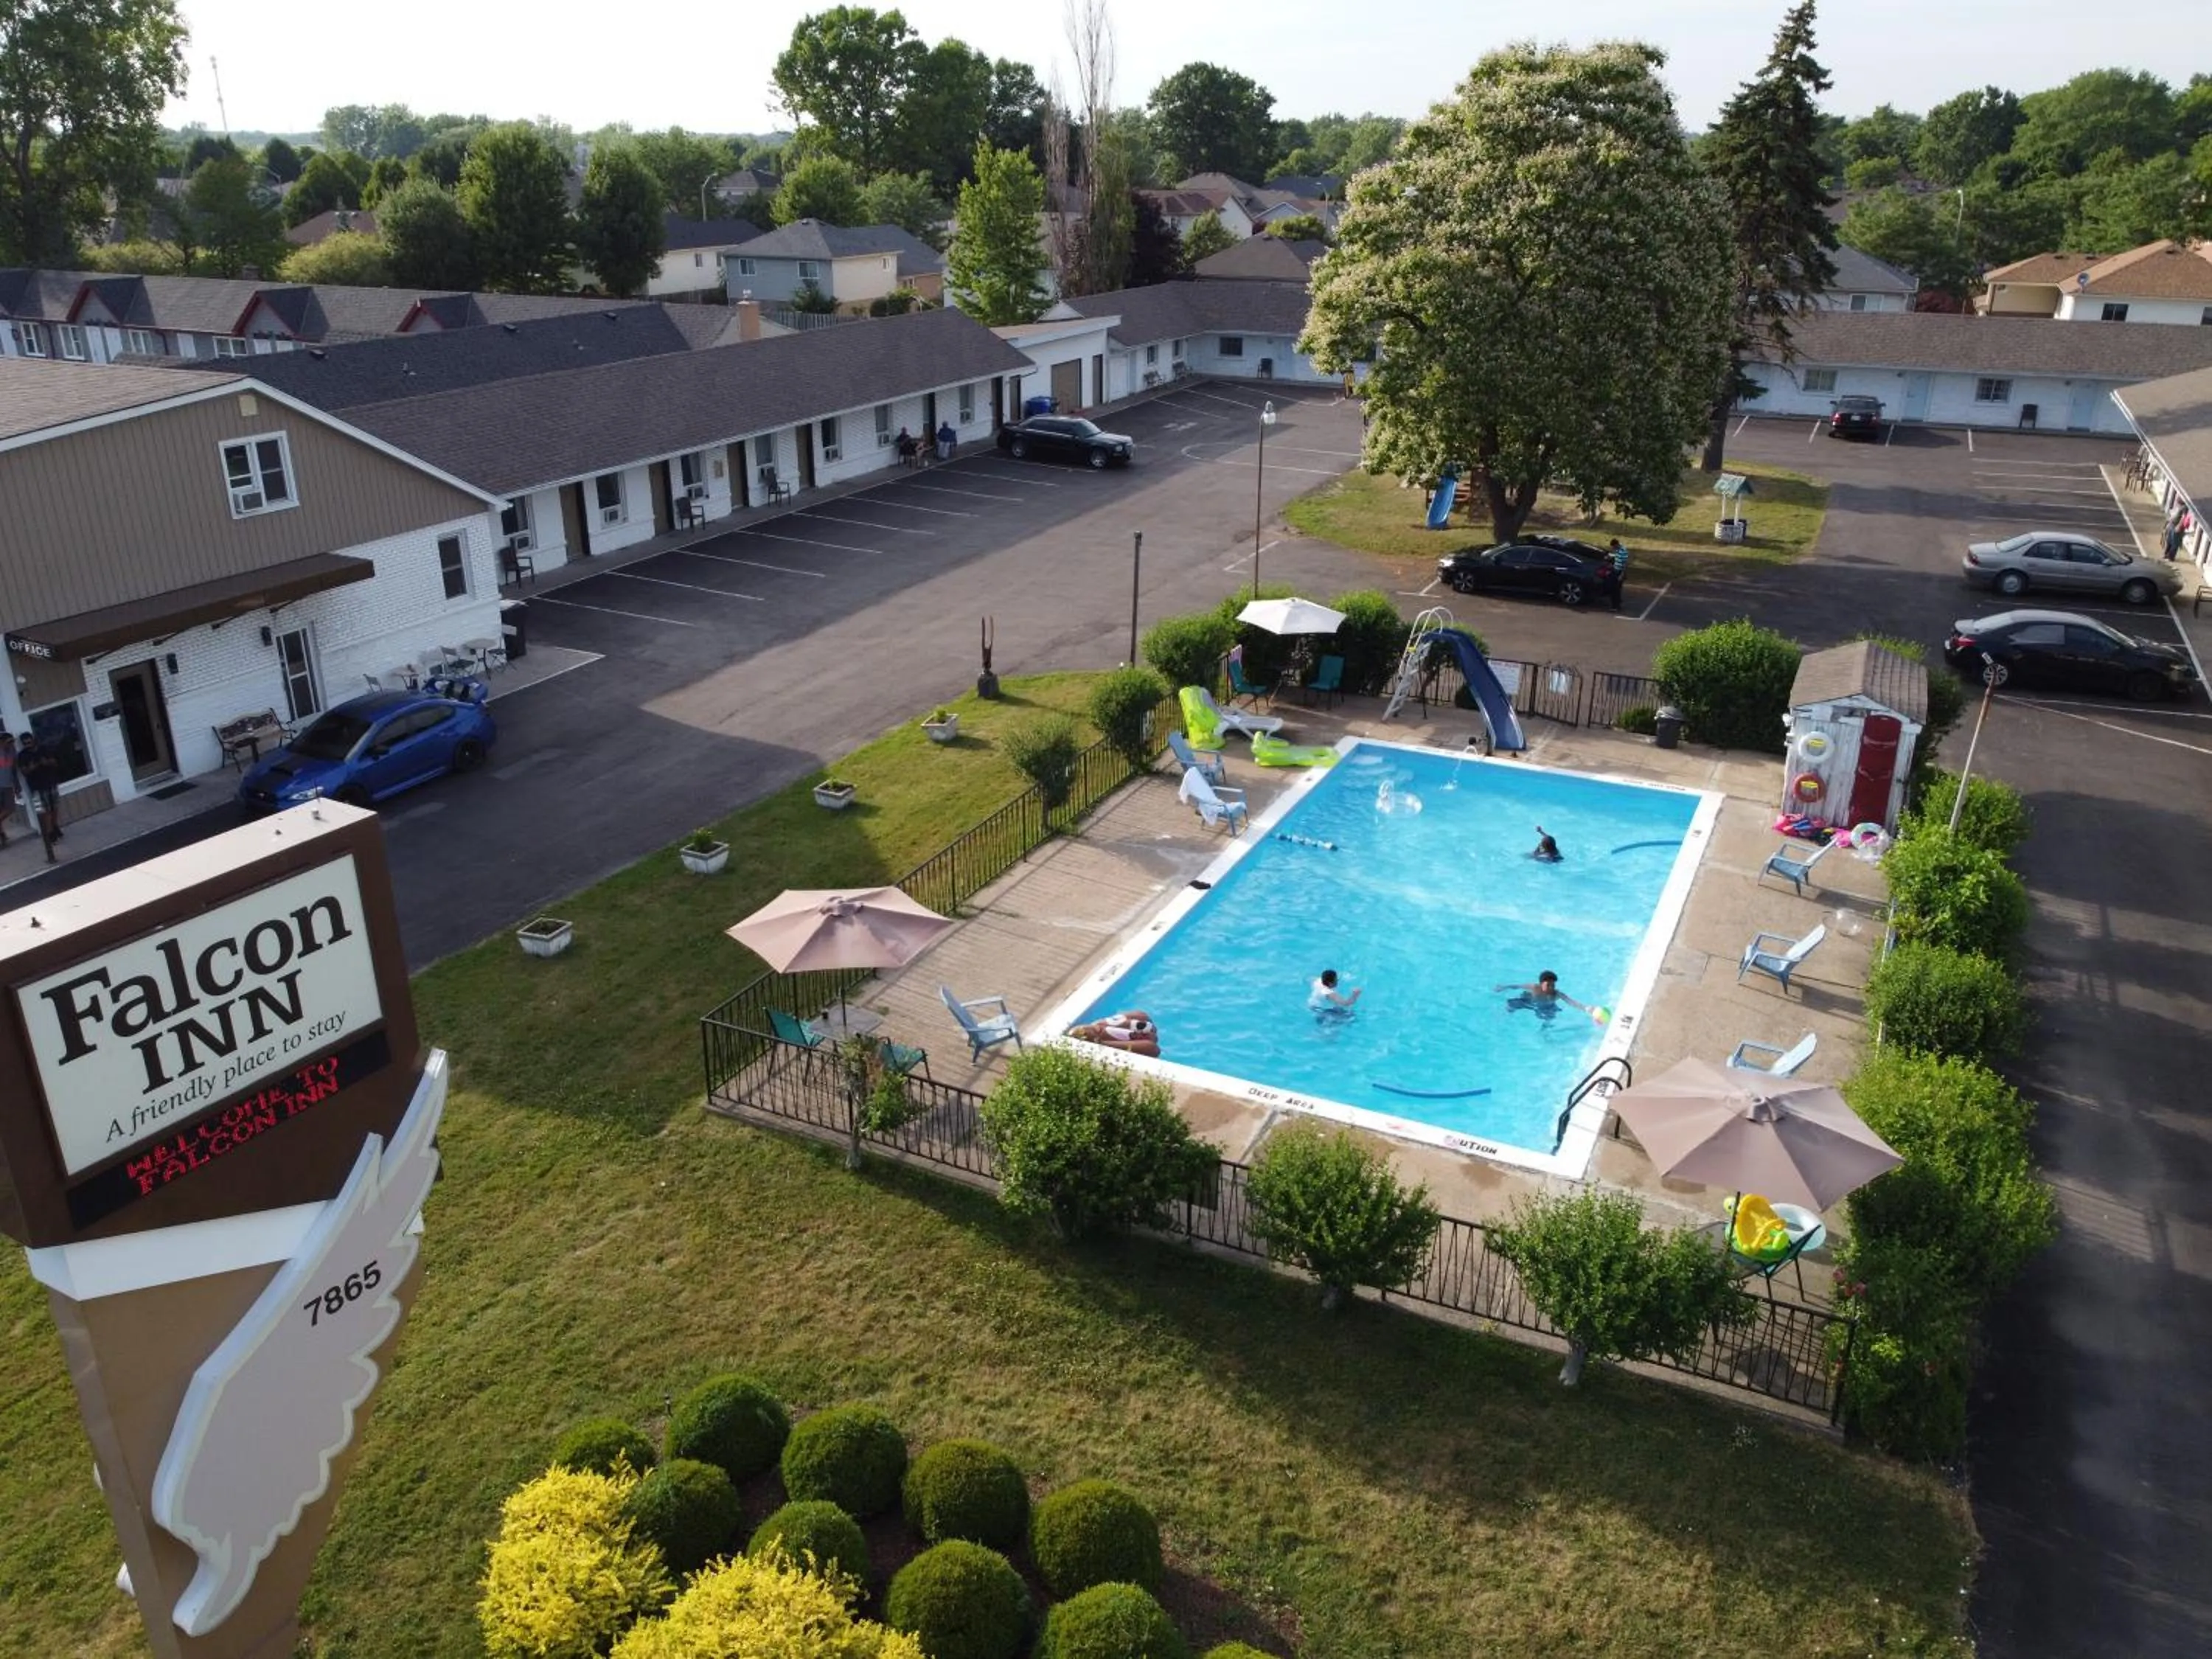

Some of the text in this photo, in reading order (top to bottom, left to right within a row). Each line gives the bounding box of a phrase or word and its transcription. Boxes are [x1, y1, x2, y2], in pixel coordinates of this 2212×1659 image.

[9, 640, 52, 658] OFFICE
[41, 895, 352, 1066] Falcon
[131, 969, 305, 1094] INN
[106, 1011, 347, 1142] A friendly place to stay
[296, 1056, 338, 1088] TO
[136, 1077, 339, 1196] FALCON INN
[303, 1259, 381, 1327] 7865
